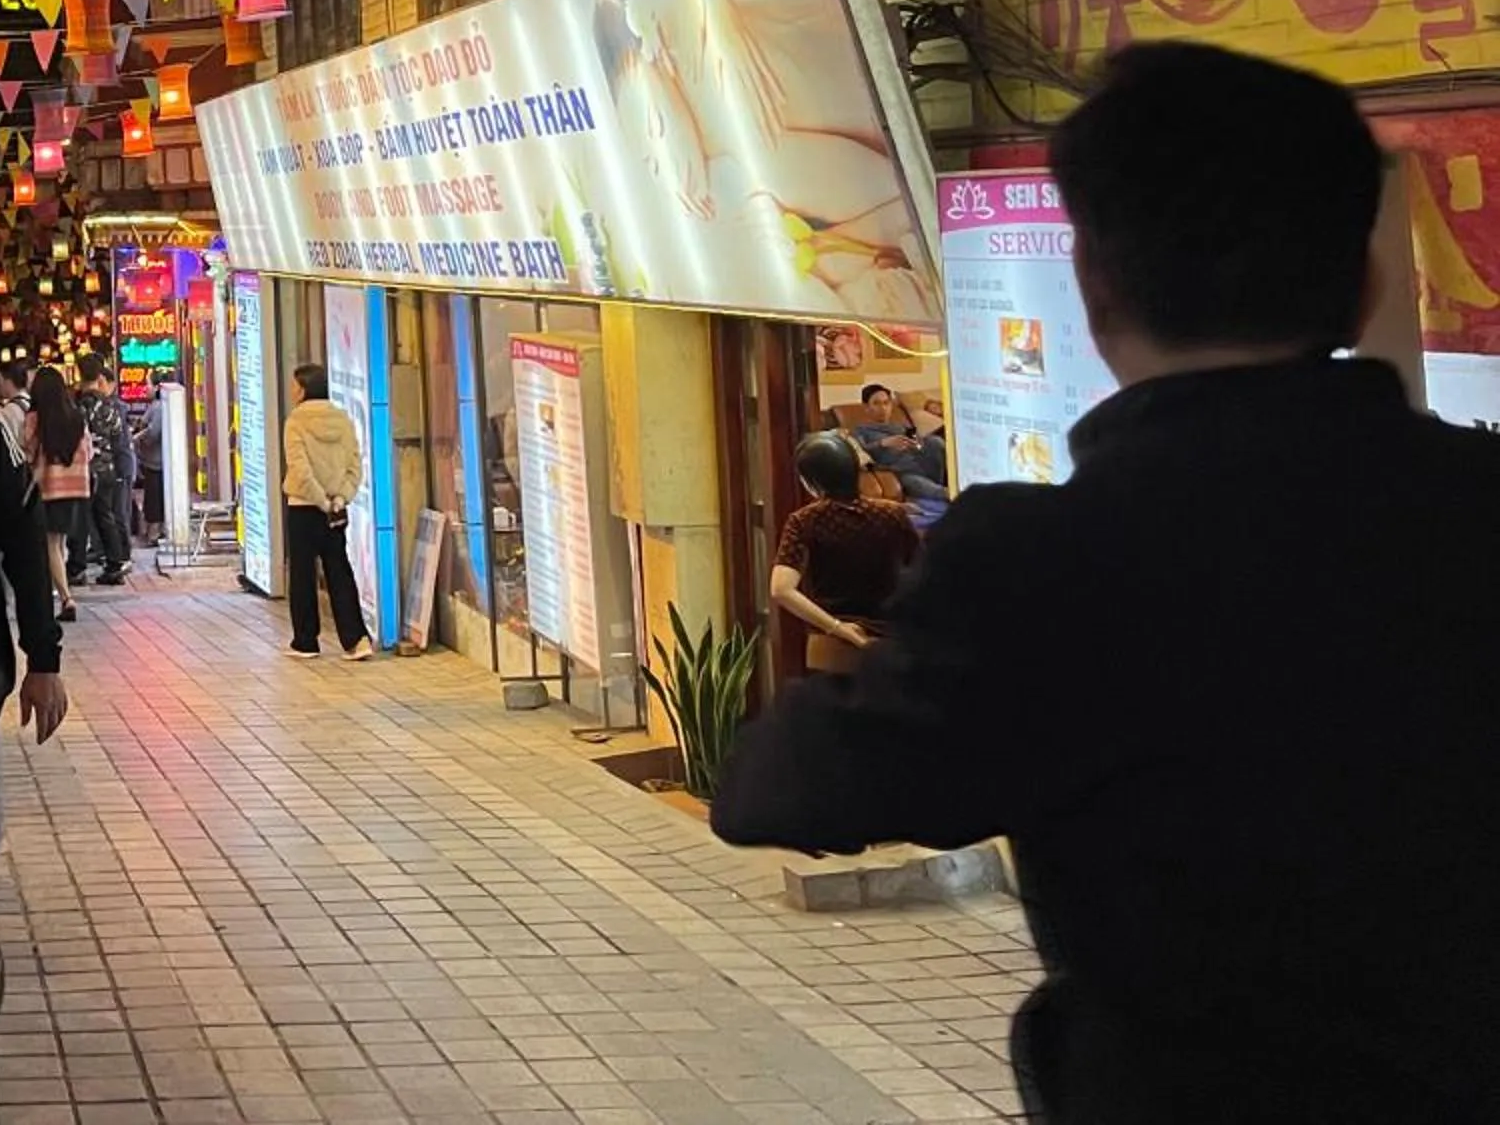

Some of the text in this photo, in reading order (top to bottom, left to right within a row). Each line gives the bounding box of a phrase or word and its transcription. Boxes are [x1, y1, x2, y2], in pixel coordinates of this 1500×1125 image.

[524, 81, 596, 137] THÂN
[376, 183, 413, 218] FOOT
[415, 174, 504, 216] MASSAGE
[1005, 182, 1038, 209] SEN
[361, 240, 420, 274] HERBAL
[418, 240, 509, 277] MEDICINE
[508, 238, 568, 281] BATH
[989, 231, 1074, 255] SERVIC
